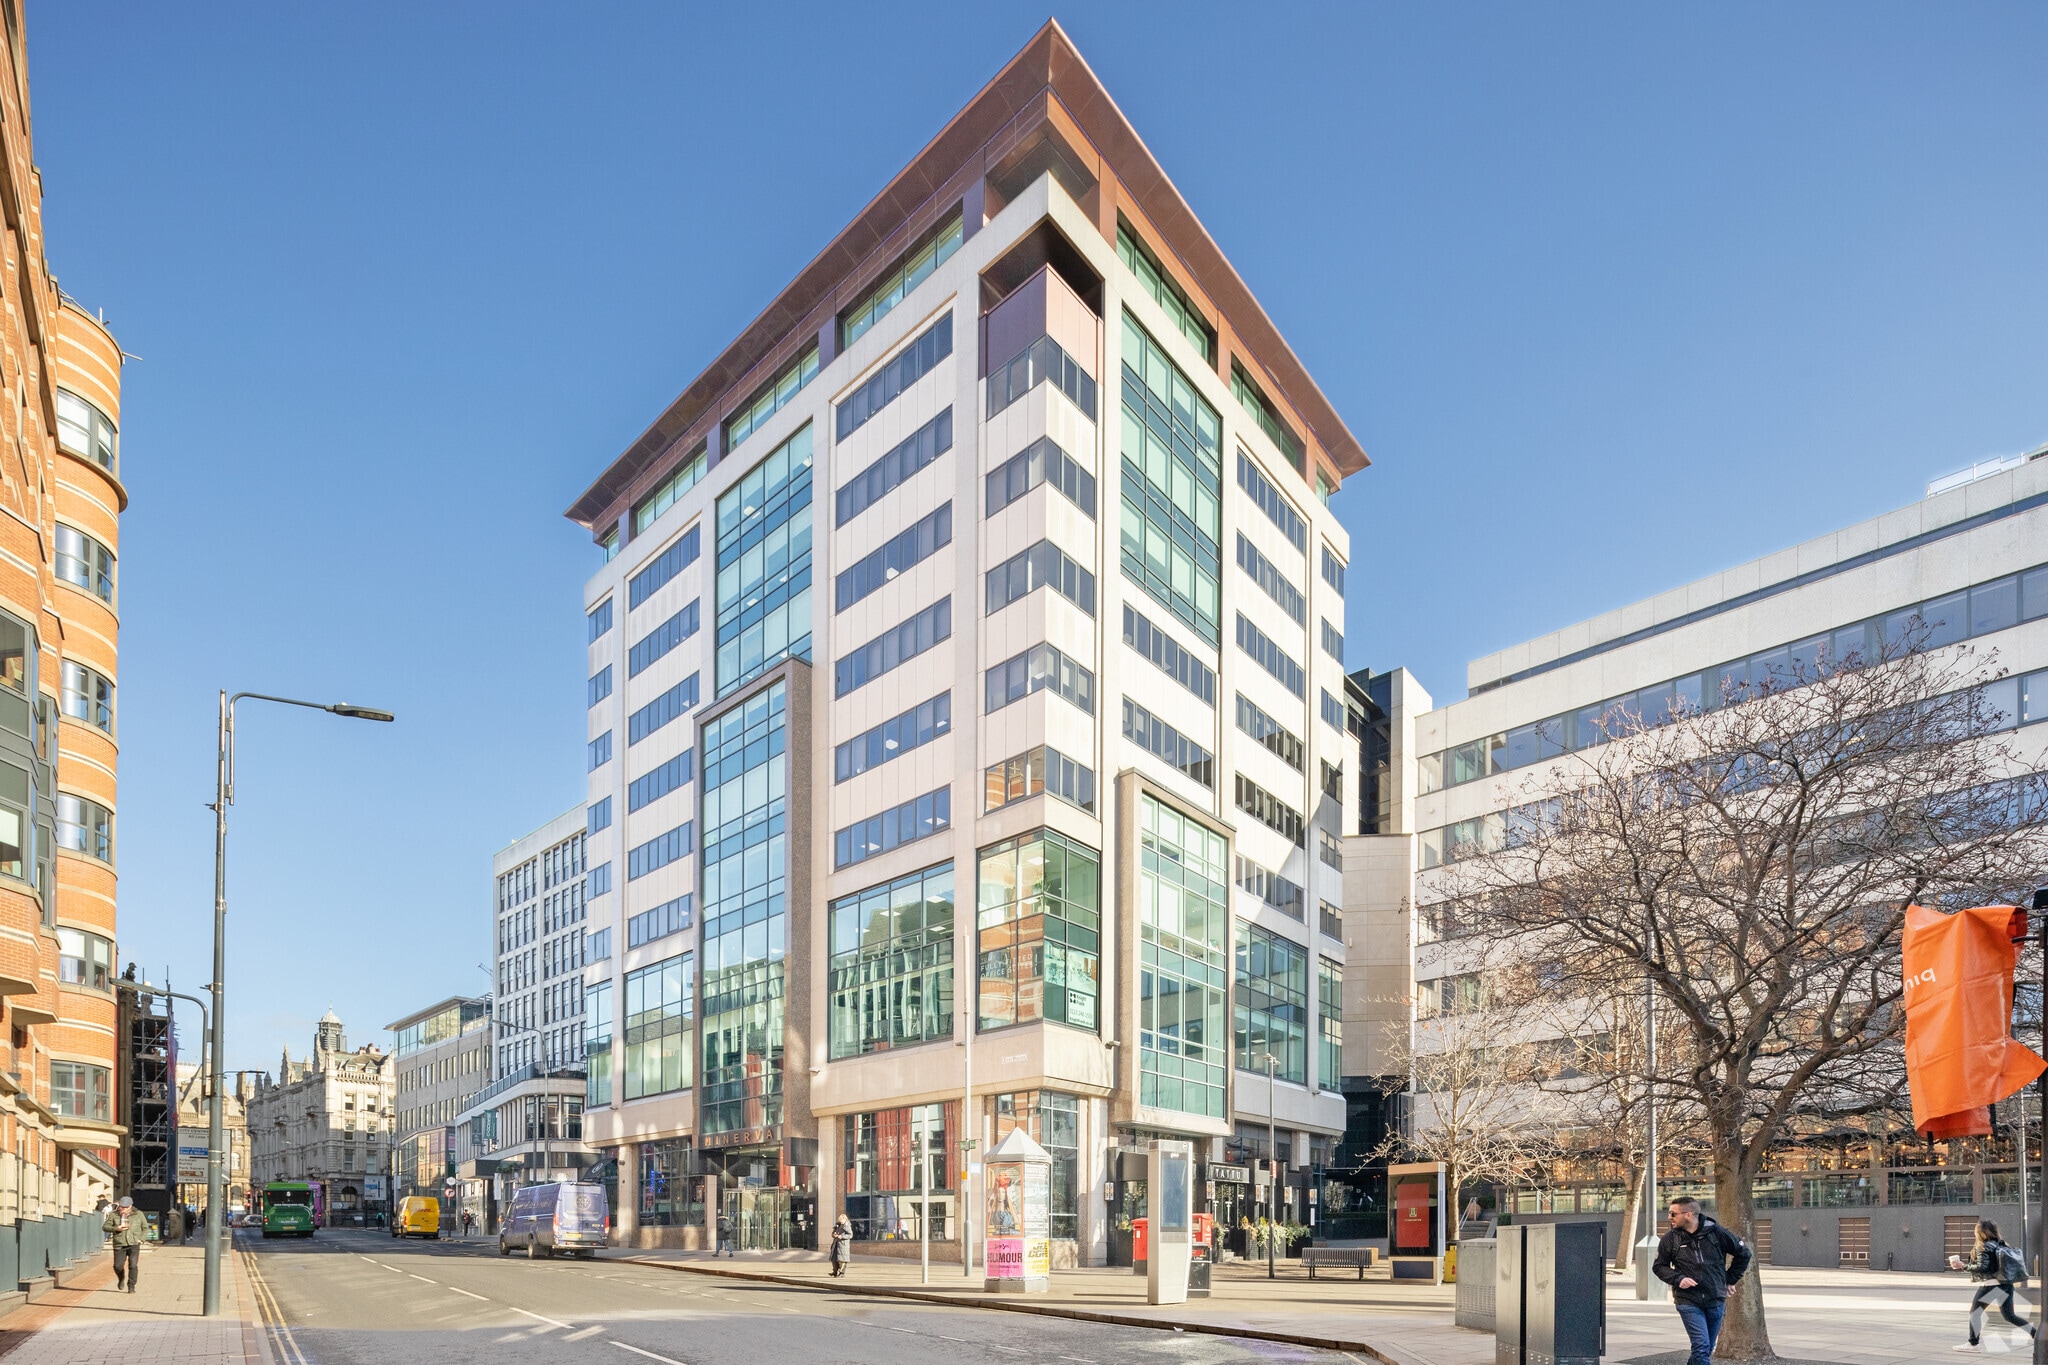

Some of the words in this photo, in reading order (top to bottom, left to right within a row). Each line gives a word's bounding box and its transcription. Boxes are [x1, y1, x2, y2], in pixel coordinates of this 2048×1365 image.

[980, 961, 1002, 972] FULLY
[980, 968, 1005, 979] OFFICE
[704, 1130, 774, 1147] MINERVA
[1215, 1168, 1241, 1180] TATTU
